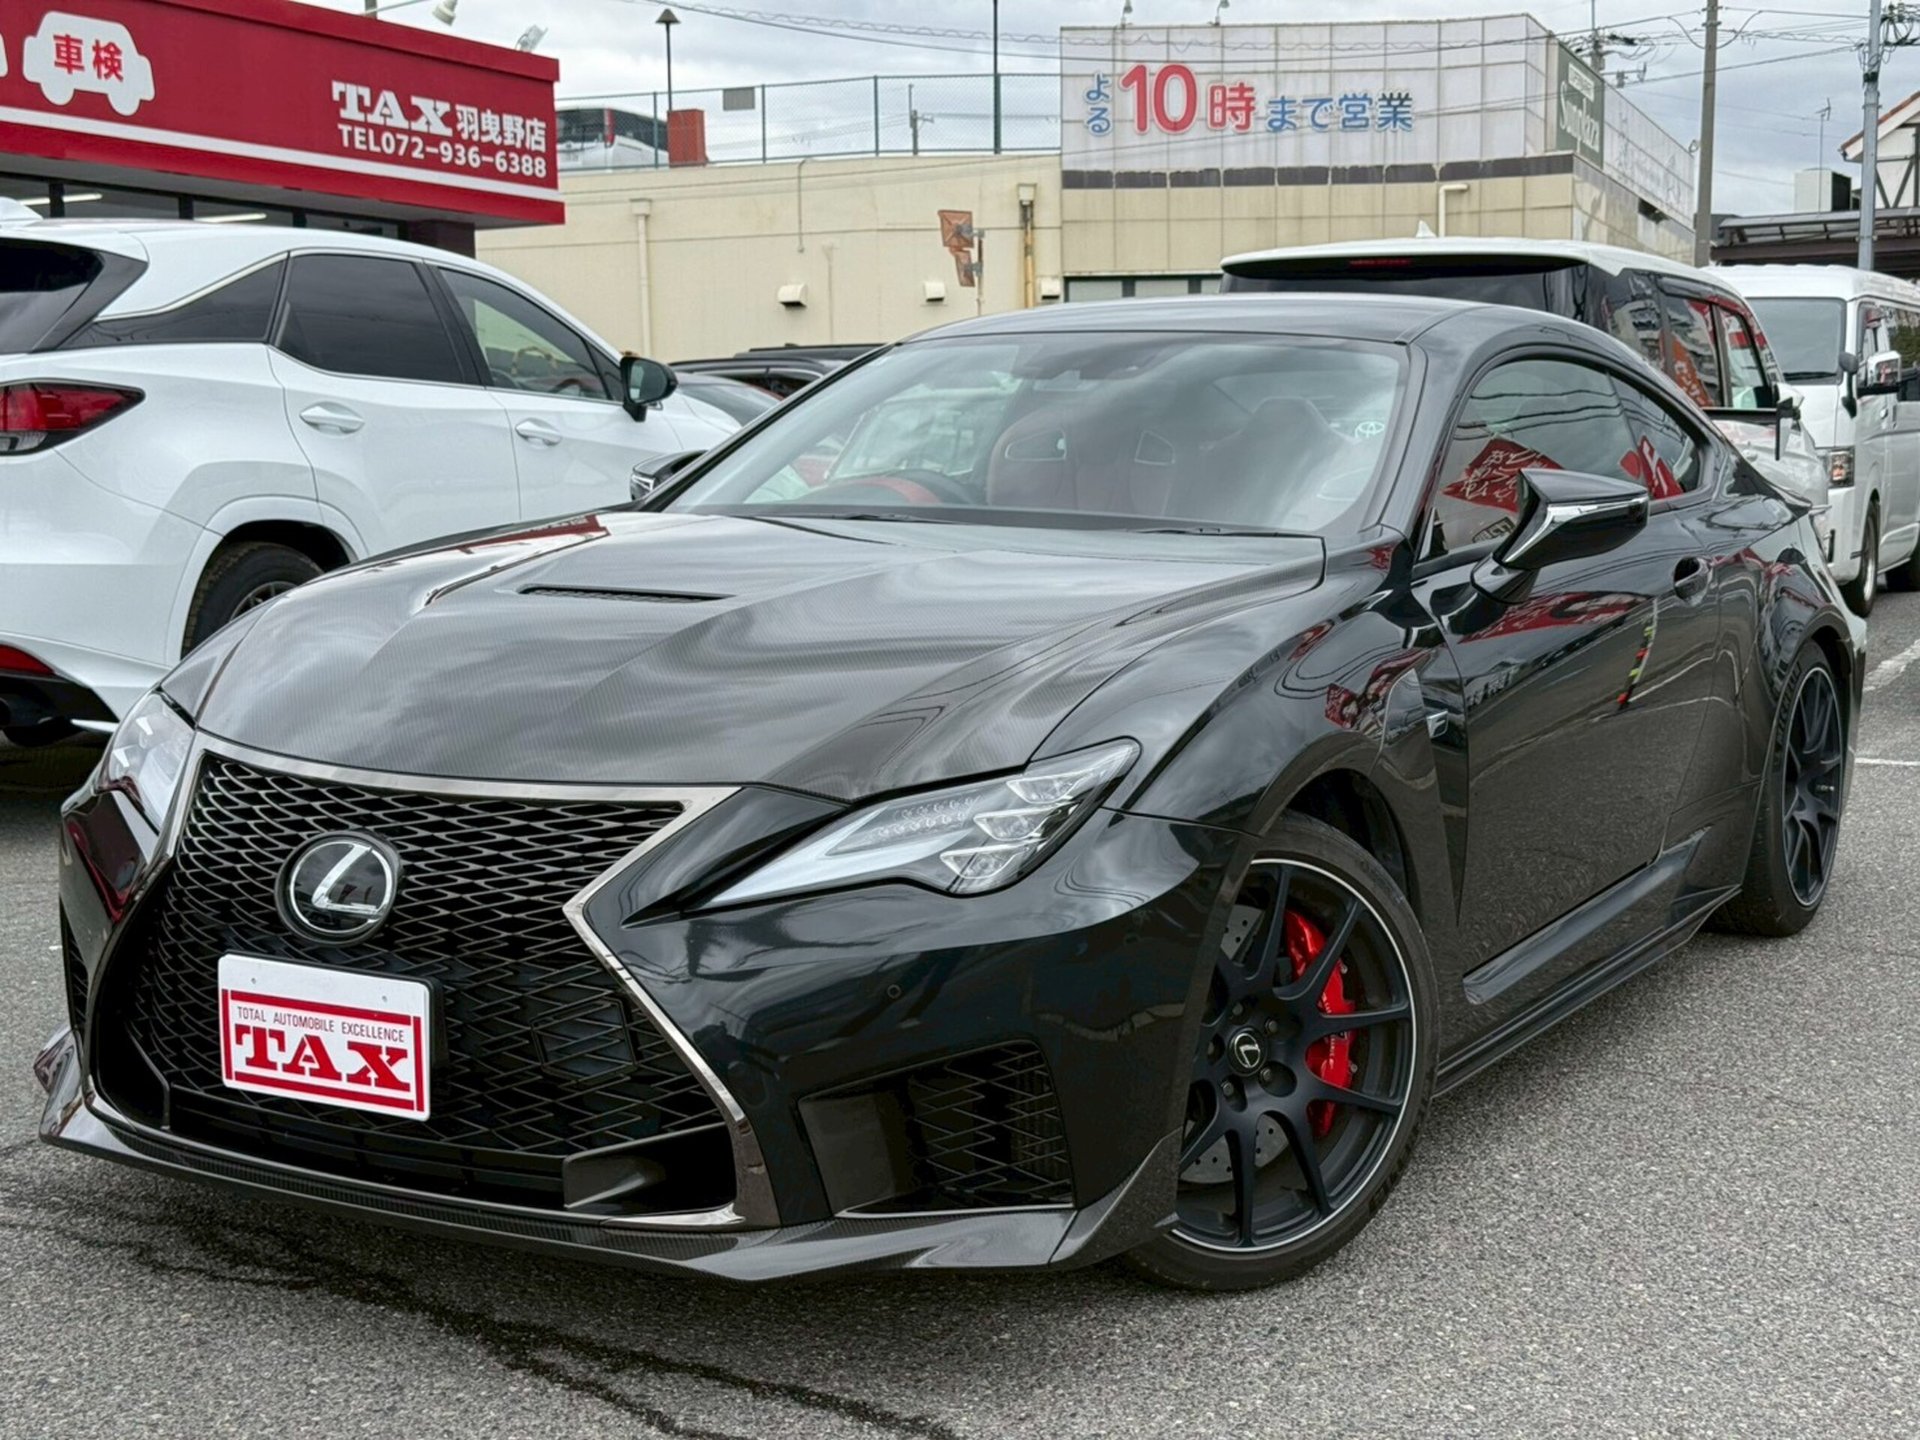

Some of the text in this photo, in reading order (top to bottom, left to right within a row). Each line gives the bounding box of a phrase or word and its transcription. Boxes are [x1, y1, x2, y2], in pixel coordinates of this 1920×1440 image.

[53, 34, 124, 82] 車検
[332, 80, 547, 153] TAX 羽曳野店
[338, 123, 547, 179] TEL072-936-6388
[237, 1006, 405, 1043] TOTAL AUTOMOBILE EXCELLENCE
[234, 1023, 411, 1092] TAX
